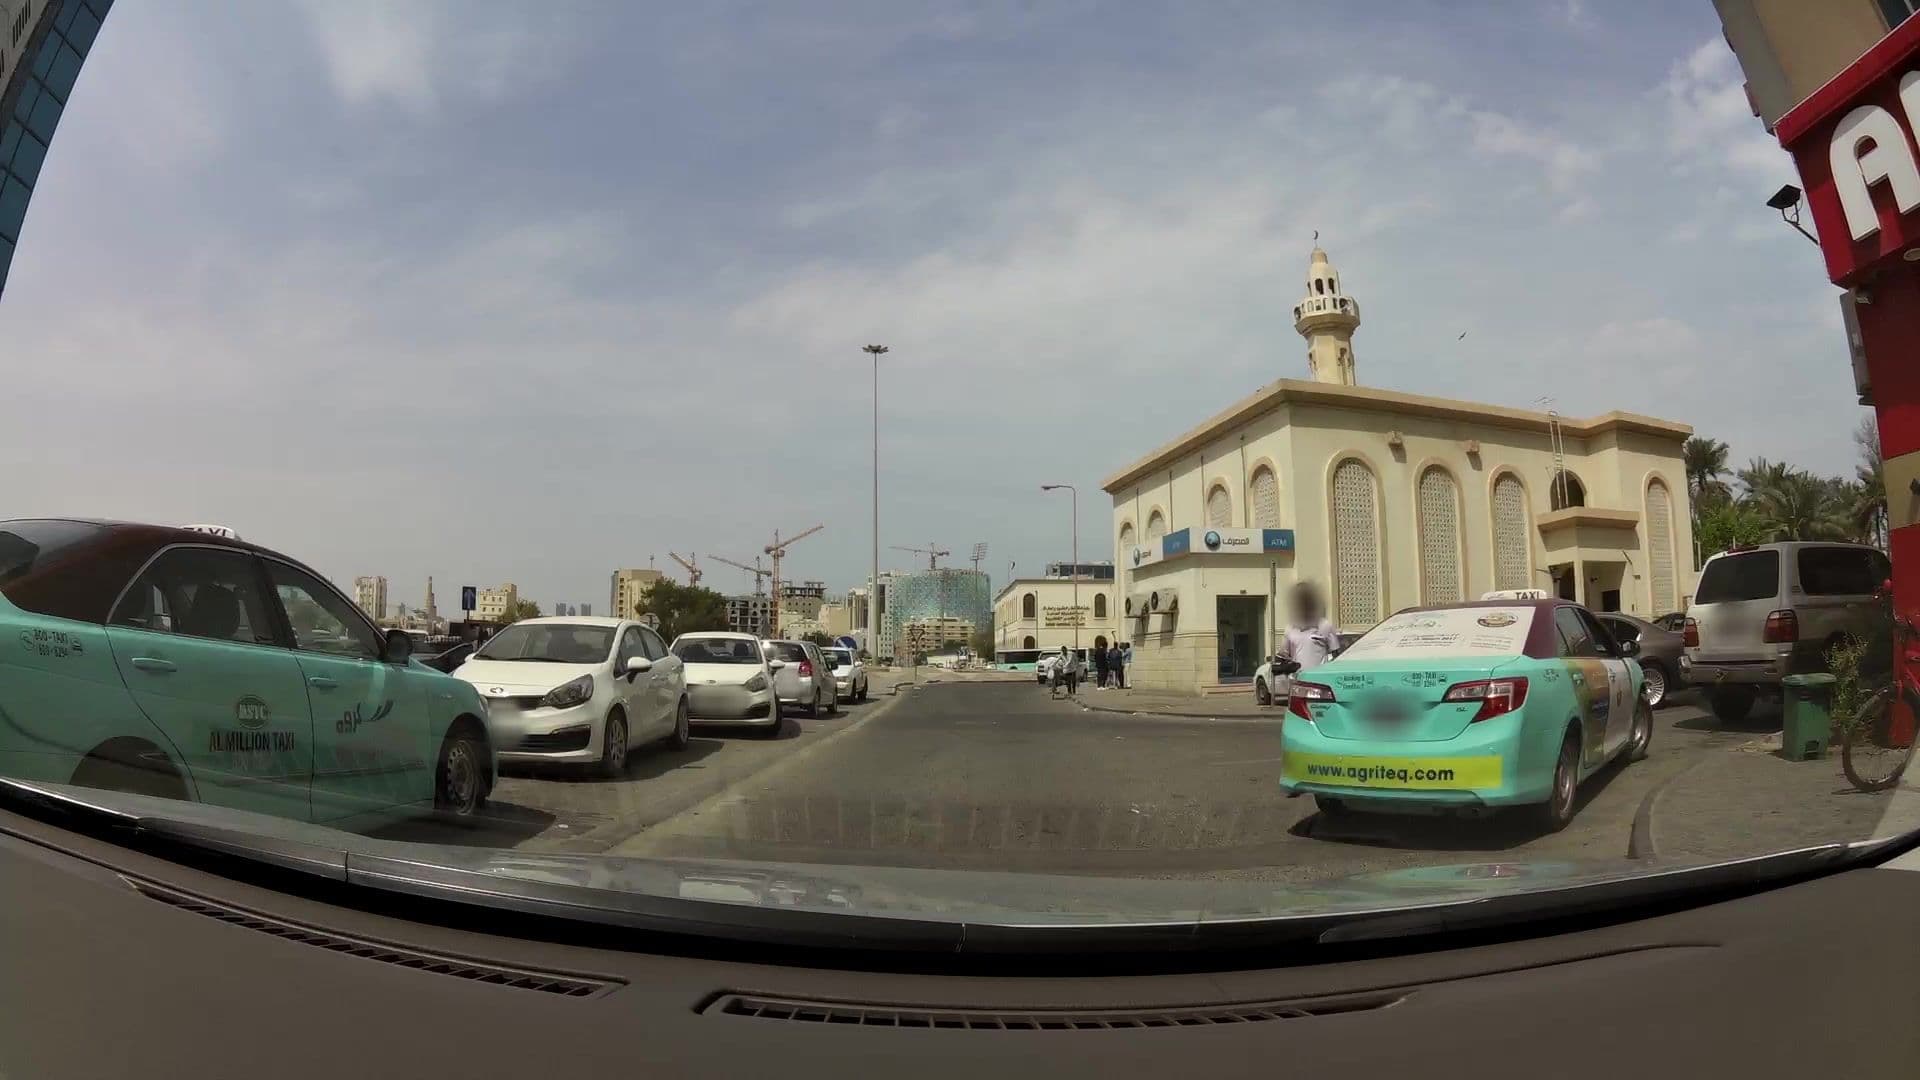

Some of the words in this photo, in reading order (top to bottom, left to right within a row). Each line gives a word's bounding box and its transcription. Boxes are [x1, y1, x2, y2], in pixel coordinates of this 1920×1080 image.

[1829, 70, 1920, 241] A
[184, 526, 226, 537] XI
[1271, 539, 1288, 547] ATM
[1515, 591, 1540, 600] TAXI
[209, 731, 224, 752] AL
[226, 731, 271, 752] MILLION
[272, 731, 295, 752] TAXI
[1307, 763, 1454, 783] www.agriteq.com
